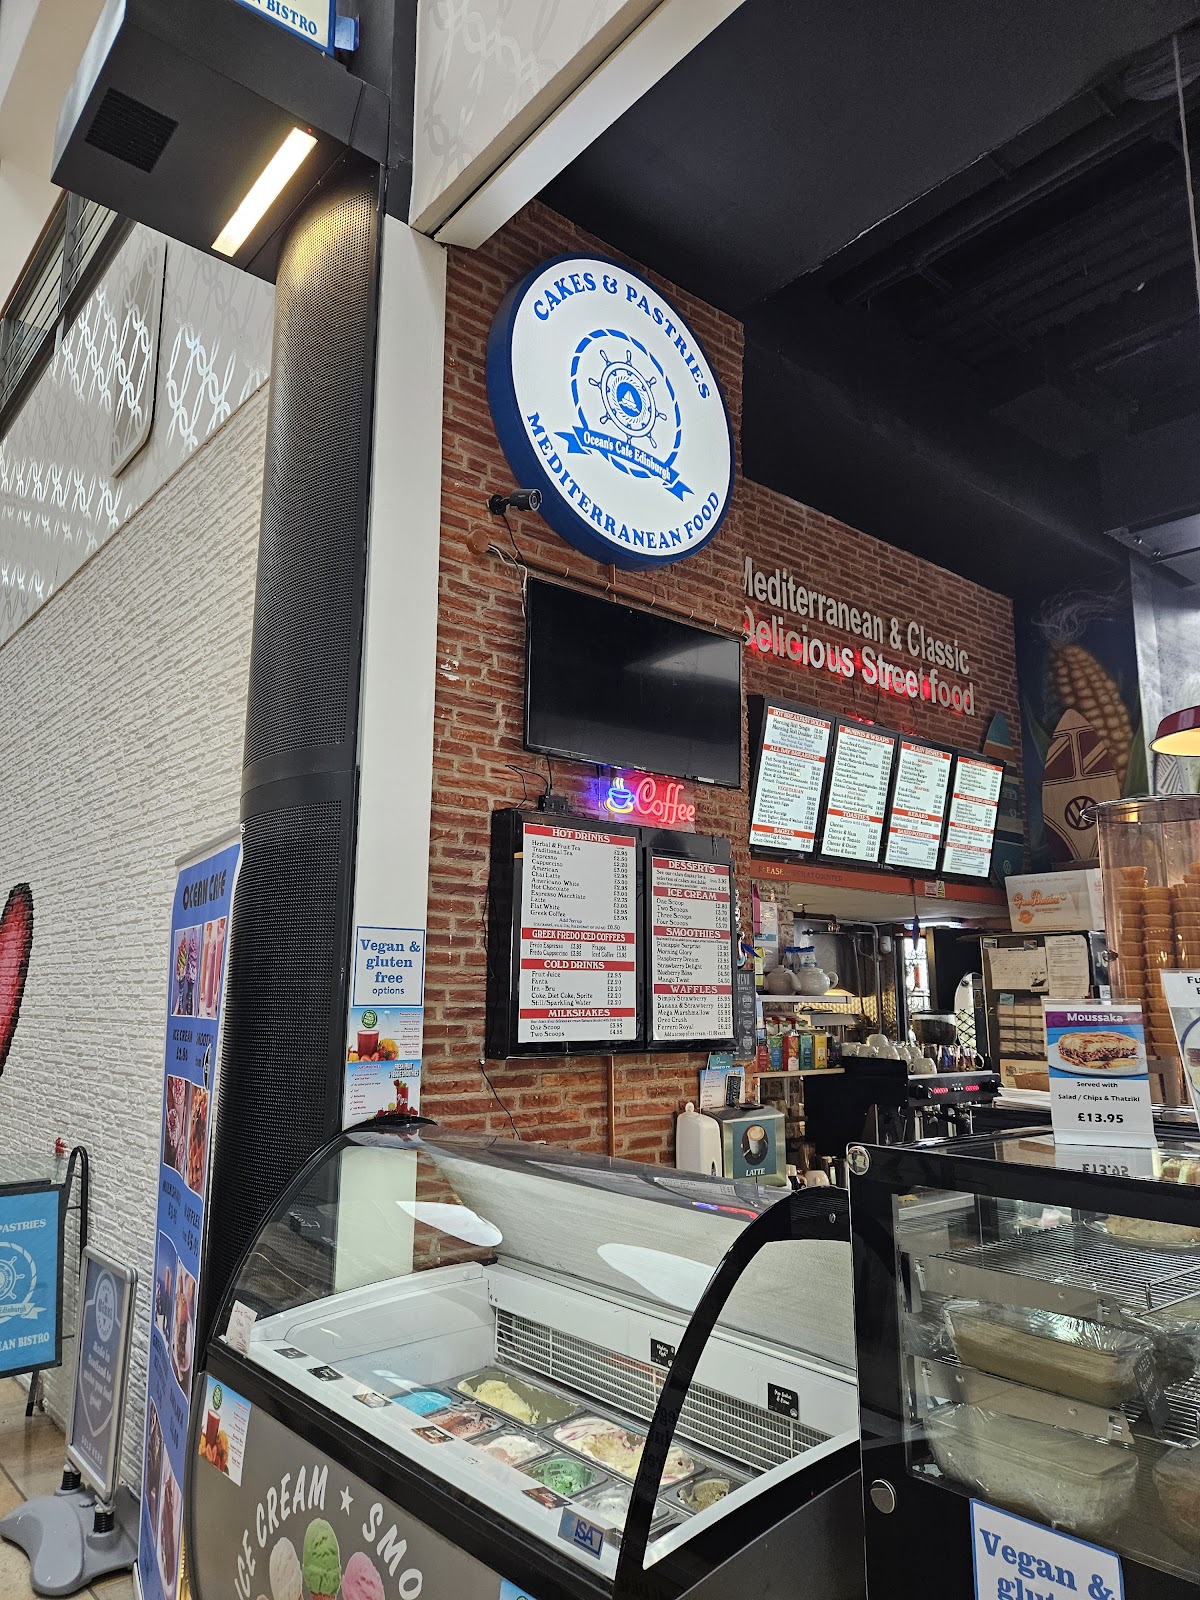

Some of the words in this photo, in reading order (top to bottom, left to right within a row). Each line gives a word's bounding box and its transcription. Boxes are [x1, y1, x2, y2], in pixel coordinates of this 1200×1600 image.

[267, 0, 317, 35] BISTRO
[534, 272, 597, 320] CAKES
[603, 274, 618, 294] &
[626, 284, 710, 400] PASTRIES
[584, 431, 613, 450] Ocean's
[616, 441, 632, 458] Cafe
[634, 449, 670, 480] Edinburgh
[527, 411, 682, 550] MEDITERRANEAN
[684, 491, 719, 539] FOOD
[890, 618, 902, 651] &
[908, 621, 970, 674] Classic
[862, 646, 925, 700] Street
[929, 669, 974, 716] food
[784, 712, 810, 723] BREAKFAST
[871, 734, 890, 744] WRAPS
[791, 750, 819, 761] BREAKFAST
[636, 777, 695, 824] Coffee
[842, 811, 870, 820] TOASTIES
[552, 828, 574, 838] HOT
[575, 831, 610, 843] DRINKS
[773, 827, 795, 835] BAGELS
[532, 840, 550, 848] Herbal
[532, 846, 562, 855] Traditional
[531, 859, 563, 867] Cappuccino
[668, 860, 715, 873] DESSERTS
[183, 878, 208, 910] OCEAN
[209, 869, 227, 901] CAFE
[668, 888, 682, 897] ICE
[684, 889, 717, 900] CREAM
[532, 930, 556, 939] GREEK
[557, 931, 579, 940] FREDO
[581, 932, 596, 940] ICED
[597, 932, 625, 941] COFFEES
[666, 928, 721, 938] SMOOTHIES
[360, 939, 404, 954] Vegan
[409, 941, 420, 953] &
[366, 956, 413, 970] gluten
[544, 960, 569, 968] COLD
[571, 961, 605, 969] DRINKS
[374, 972, 403, 983] free
[372, 987, 404, 996] options
[670, 985, 718, 993] WAFFLES
[548, 1009, 610, 1018] MILKSHAKES
[1067, 1013, 1124, 1023] Moussaka
[1083, 1094, 1102, 1102] Chips
[1078, 1113, 1124, 1123] £13.95
[746, 1168, 765, 1176] LATTE
[18, 1333, 50, 1346] BISTRO
[235, 1529, 255, 1600] ICE
[256, 1465, 329, 1548] CREAM
[362, 1503, 423, 1600] SMO
[575, 1519, 593, 1545] ISA
[980, 1528, 1077, 1591] Vegan
[1088, 1574, 1115, 1600] &
